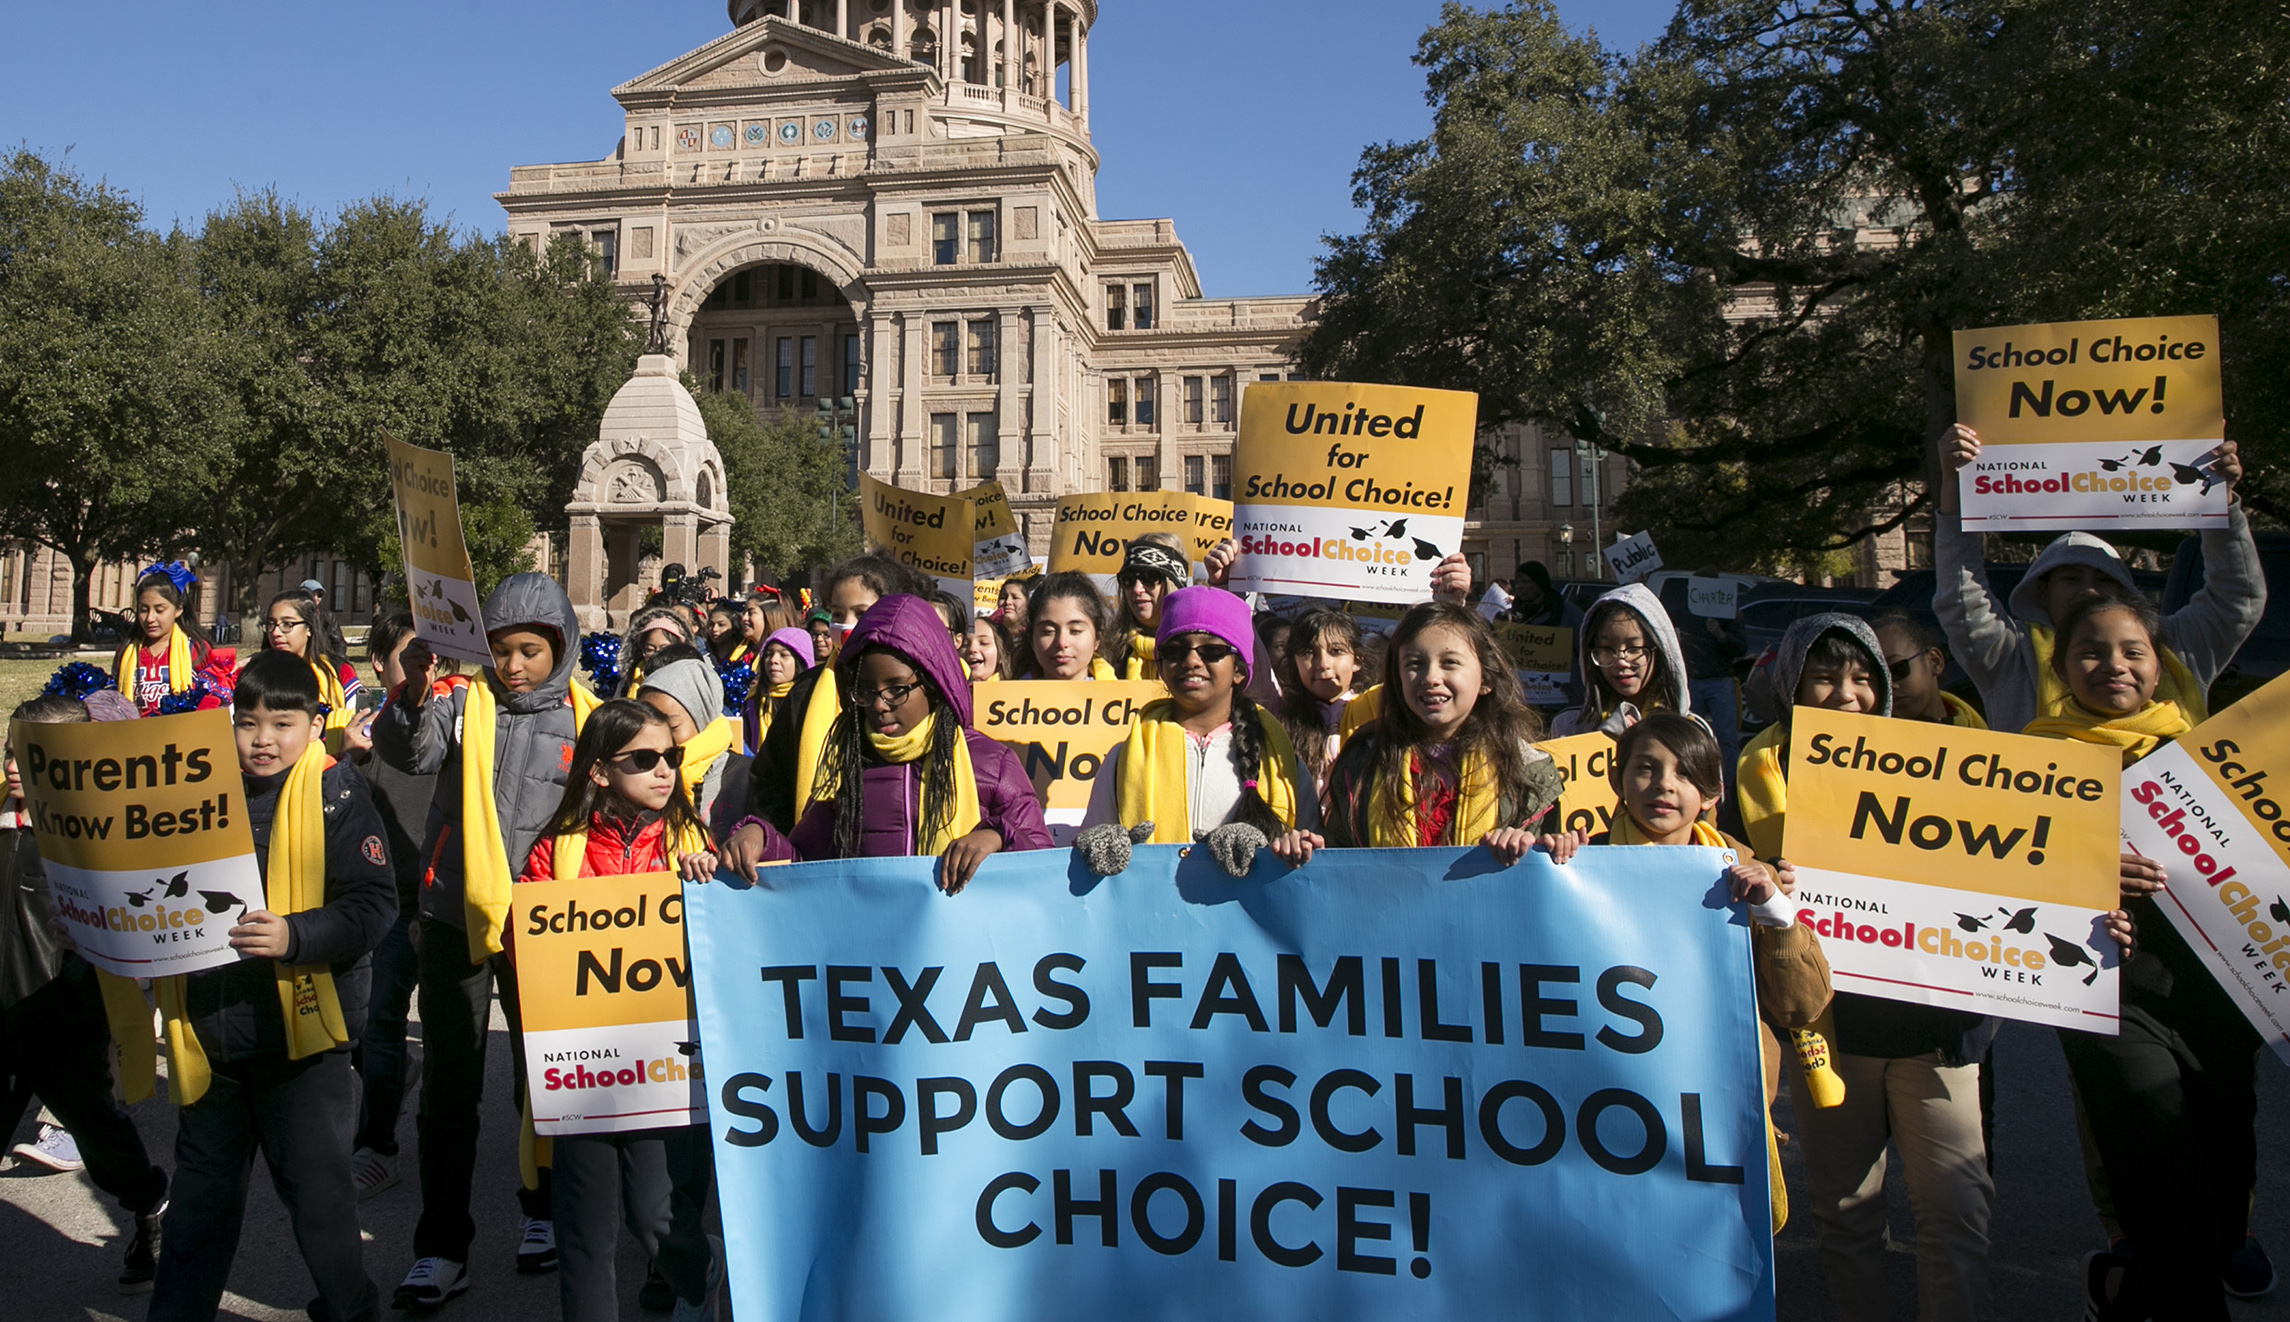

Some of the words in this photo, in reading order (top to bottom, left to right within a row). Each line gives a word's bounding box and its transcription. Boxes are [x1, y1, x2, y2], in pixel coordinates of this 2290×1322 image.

[1967, 338, 2079, 370] School
[2089, 334, 2205, 363] Choice
[2008, 375, 2167, 418] Now!
[1285, 402, 1425, 439] United
[1326, 443, 1369, 468] for
[1976, 461, 2047, 471] NATIONAL
[404, 461, 449, 498] Choice
[1245, 474, 1336, 500] School
[1345, 479, 1453, 509] Choice!
[1974, 471, 2172, 494] SchoolChoice
[874, 491, 946, 529] United
[975, 492, 1002, 507] oice
[1059, 503, 1119, 522] School
[1123, 503, 1187, 522] Choice
[2123, 493, 2171, 503] WEEK
[400, 509, 437, 548] ow!
[891, 525, 913, 544] for
[1243, 522, 1302, 533] NATIONAL
[901, 551, 966, 575] Choice!
[1241, 535, 1411, 565] SchoolChoice
[1612, 542, 1655, 575] Public
[1366, 565, 1408, 577] WEEK
[430, 623, 456, 636] WEEK
[1507, 629, 1556, 646] United
[1520, 646, 1536, 656] for
[986, 698, 1092, 726] School
[27, 743, 213, 791] Parents
[1806, 733, 1948, 780] School
[1958, 753, 2104, 802] Choice
[2159, 771, 2231, 849] NATIONAL
[2200, 739, 2290, 852] Schoo
[35, 800, 114, 840] Know
[125, 793, 230, 840] Best!
[1849, 790, 2052, 866] Now!
[54, 880, 89, 900] NATIONAL
[2131, 780, 2290, 984] SchoolChoic
[527, 894, 648, 936] School
[1800, 891, 1889, 915] NATIONAL
[153, 928, 205, 944] WEEK
[1796, 908, 2046, 970] SchoolChoice
[153, 945, 231, 962] www.schoolchoiceweek.c
[1982, 965, 2043, 986] WEEK
[2241, 943, 2287, 995] WEEK
[761, 952, 1092, 1046] TEXAS
[1130, 951, 1665, 1054] FAMILIES
[1975, 990, 2081, 1013] www.schoolchoiceweek.com
[2217, 951, 2284, 1032] www.schoolchoiceweek.com
[300, 1005, 319, 1016] Cho
[544, 1048, 621, 1062] NATIONAL
[544, 1057, 705, 1091] SchoolCho
[561, 1114, 582, 1122] #SCW
[722, 1060, 1206, 1156] SUPPORT
[1240, 1064, 1746, 1186] SCHOOL
[975, 1168, 1432, 1280] CHOICE!
